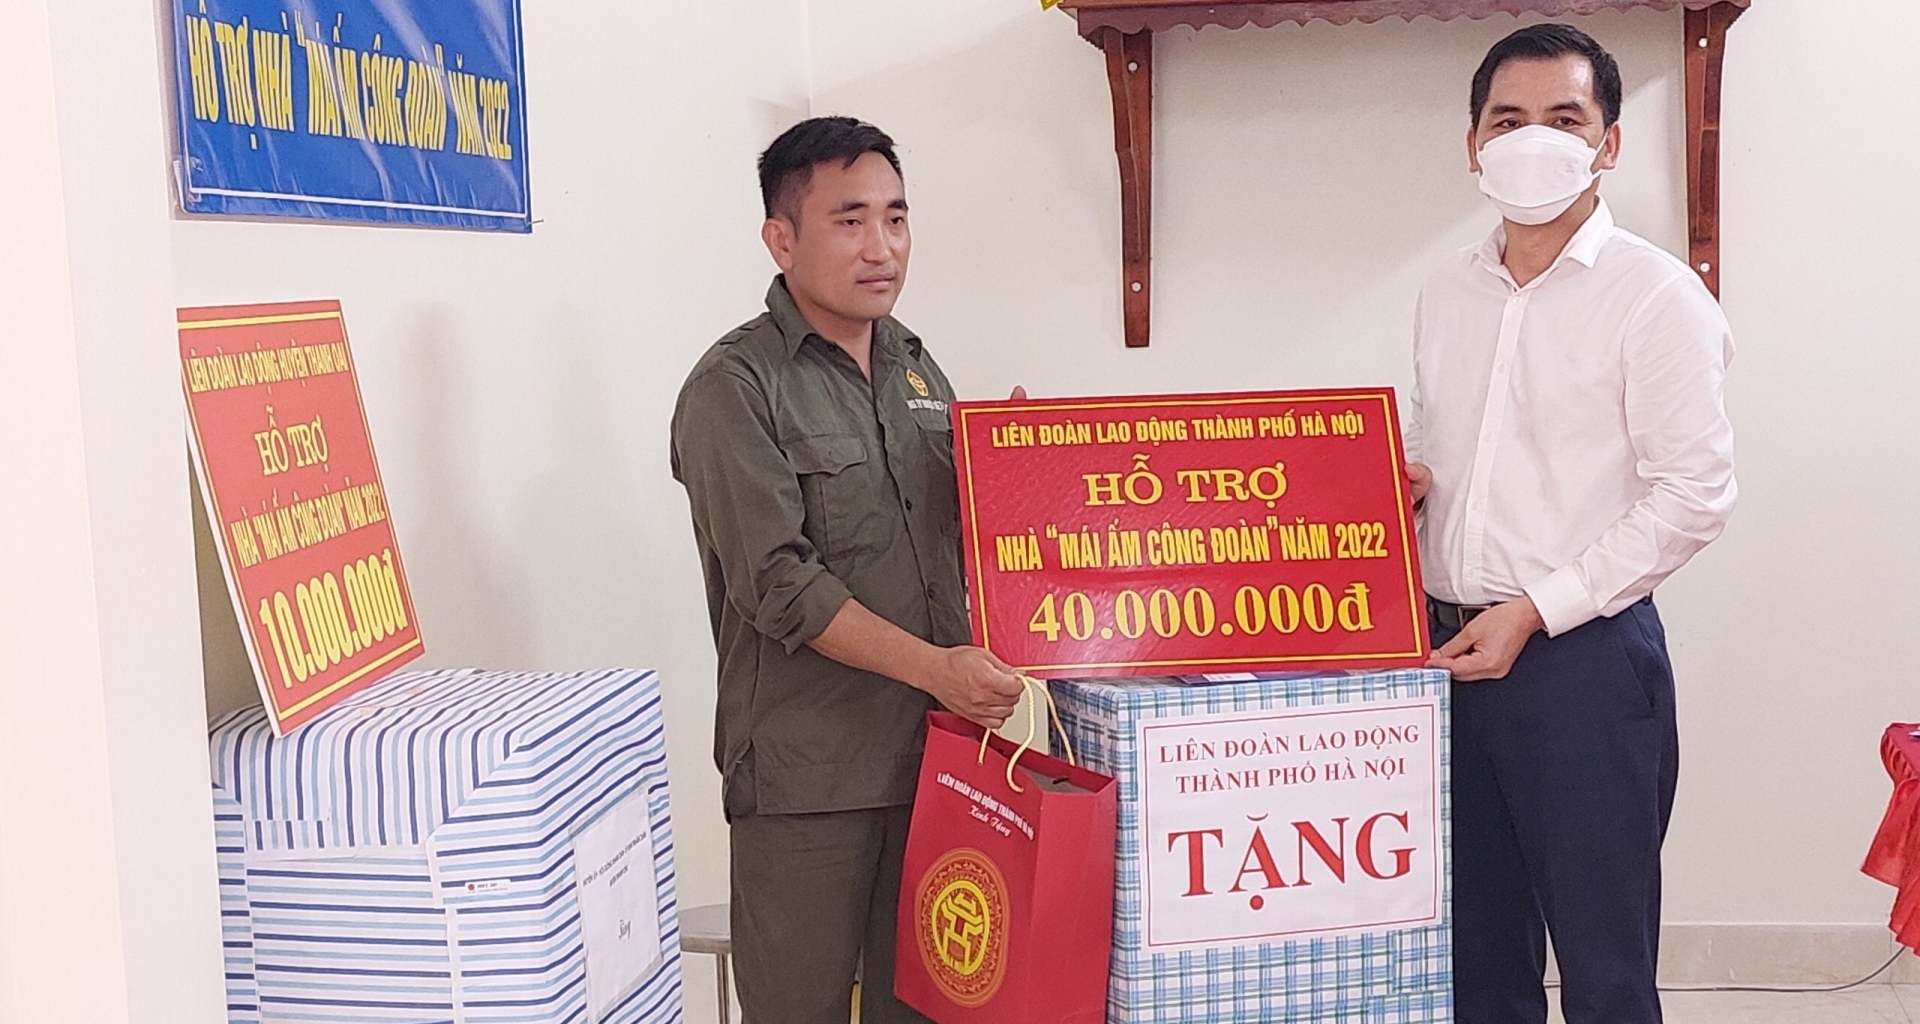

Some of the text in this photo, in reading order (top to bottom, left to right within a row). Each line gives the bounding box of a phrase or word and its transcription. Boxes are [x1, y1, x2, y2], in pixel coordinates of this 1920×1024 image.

[214, 16, 257, 150] TRỢ
[252, 11, 294, 132] NHÀ
[361, 33, 406, 147] CÔNG
[447, 53, 486, 157] NĂM
[479, 77, 512, 160] 2022
[185, 349, 212, 393] LIÊN
[238, 352, 256, 387] LAO
[276, 338, 310, 388] HUYỆN
[303, 344, 335, 377] THANH
[331, 341, 349, 373] OAI
[254, 404, 329, 476] HỖ TRỢ
[992, 408, 1365, 447] LIÊN ĐOÀN LAO ĐỘNG THÀNH PHỐ HÀ NỘI
[1081, 453, 1287, 509] HỖ TRỢ
[230, 505, 262, 569] NHÀ
[290, 491, 323, 549] CÔNG
[342, 476, 368, 531] NĂM
[361, 481, 386, 525] 2022
[995, 527, 1044, 572] NHÀ
[1107, 517, 1143, 567] ẤM
[1146, 521, 1207, 565] CÔNG
[1278, 516, 1332, 561] NĂM
[1334, 522, 1388, 559] 2022
[259, 547, 408, 689] 10.000.000đ
[1028, 582, 1375, 642] 40.000.000đ
[1160, 725, 1420, 763] LIÊN ĐOÀN LAO ĐỘNG
[1176, 756, 1406, 793] THÀNH PHỐ HÀ NỘI
[1168, 810, 1417, 911] TẶNG
